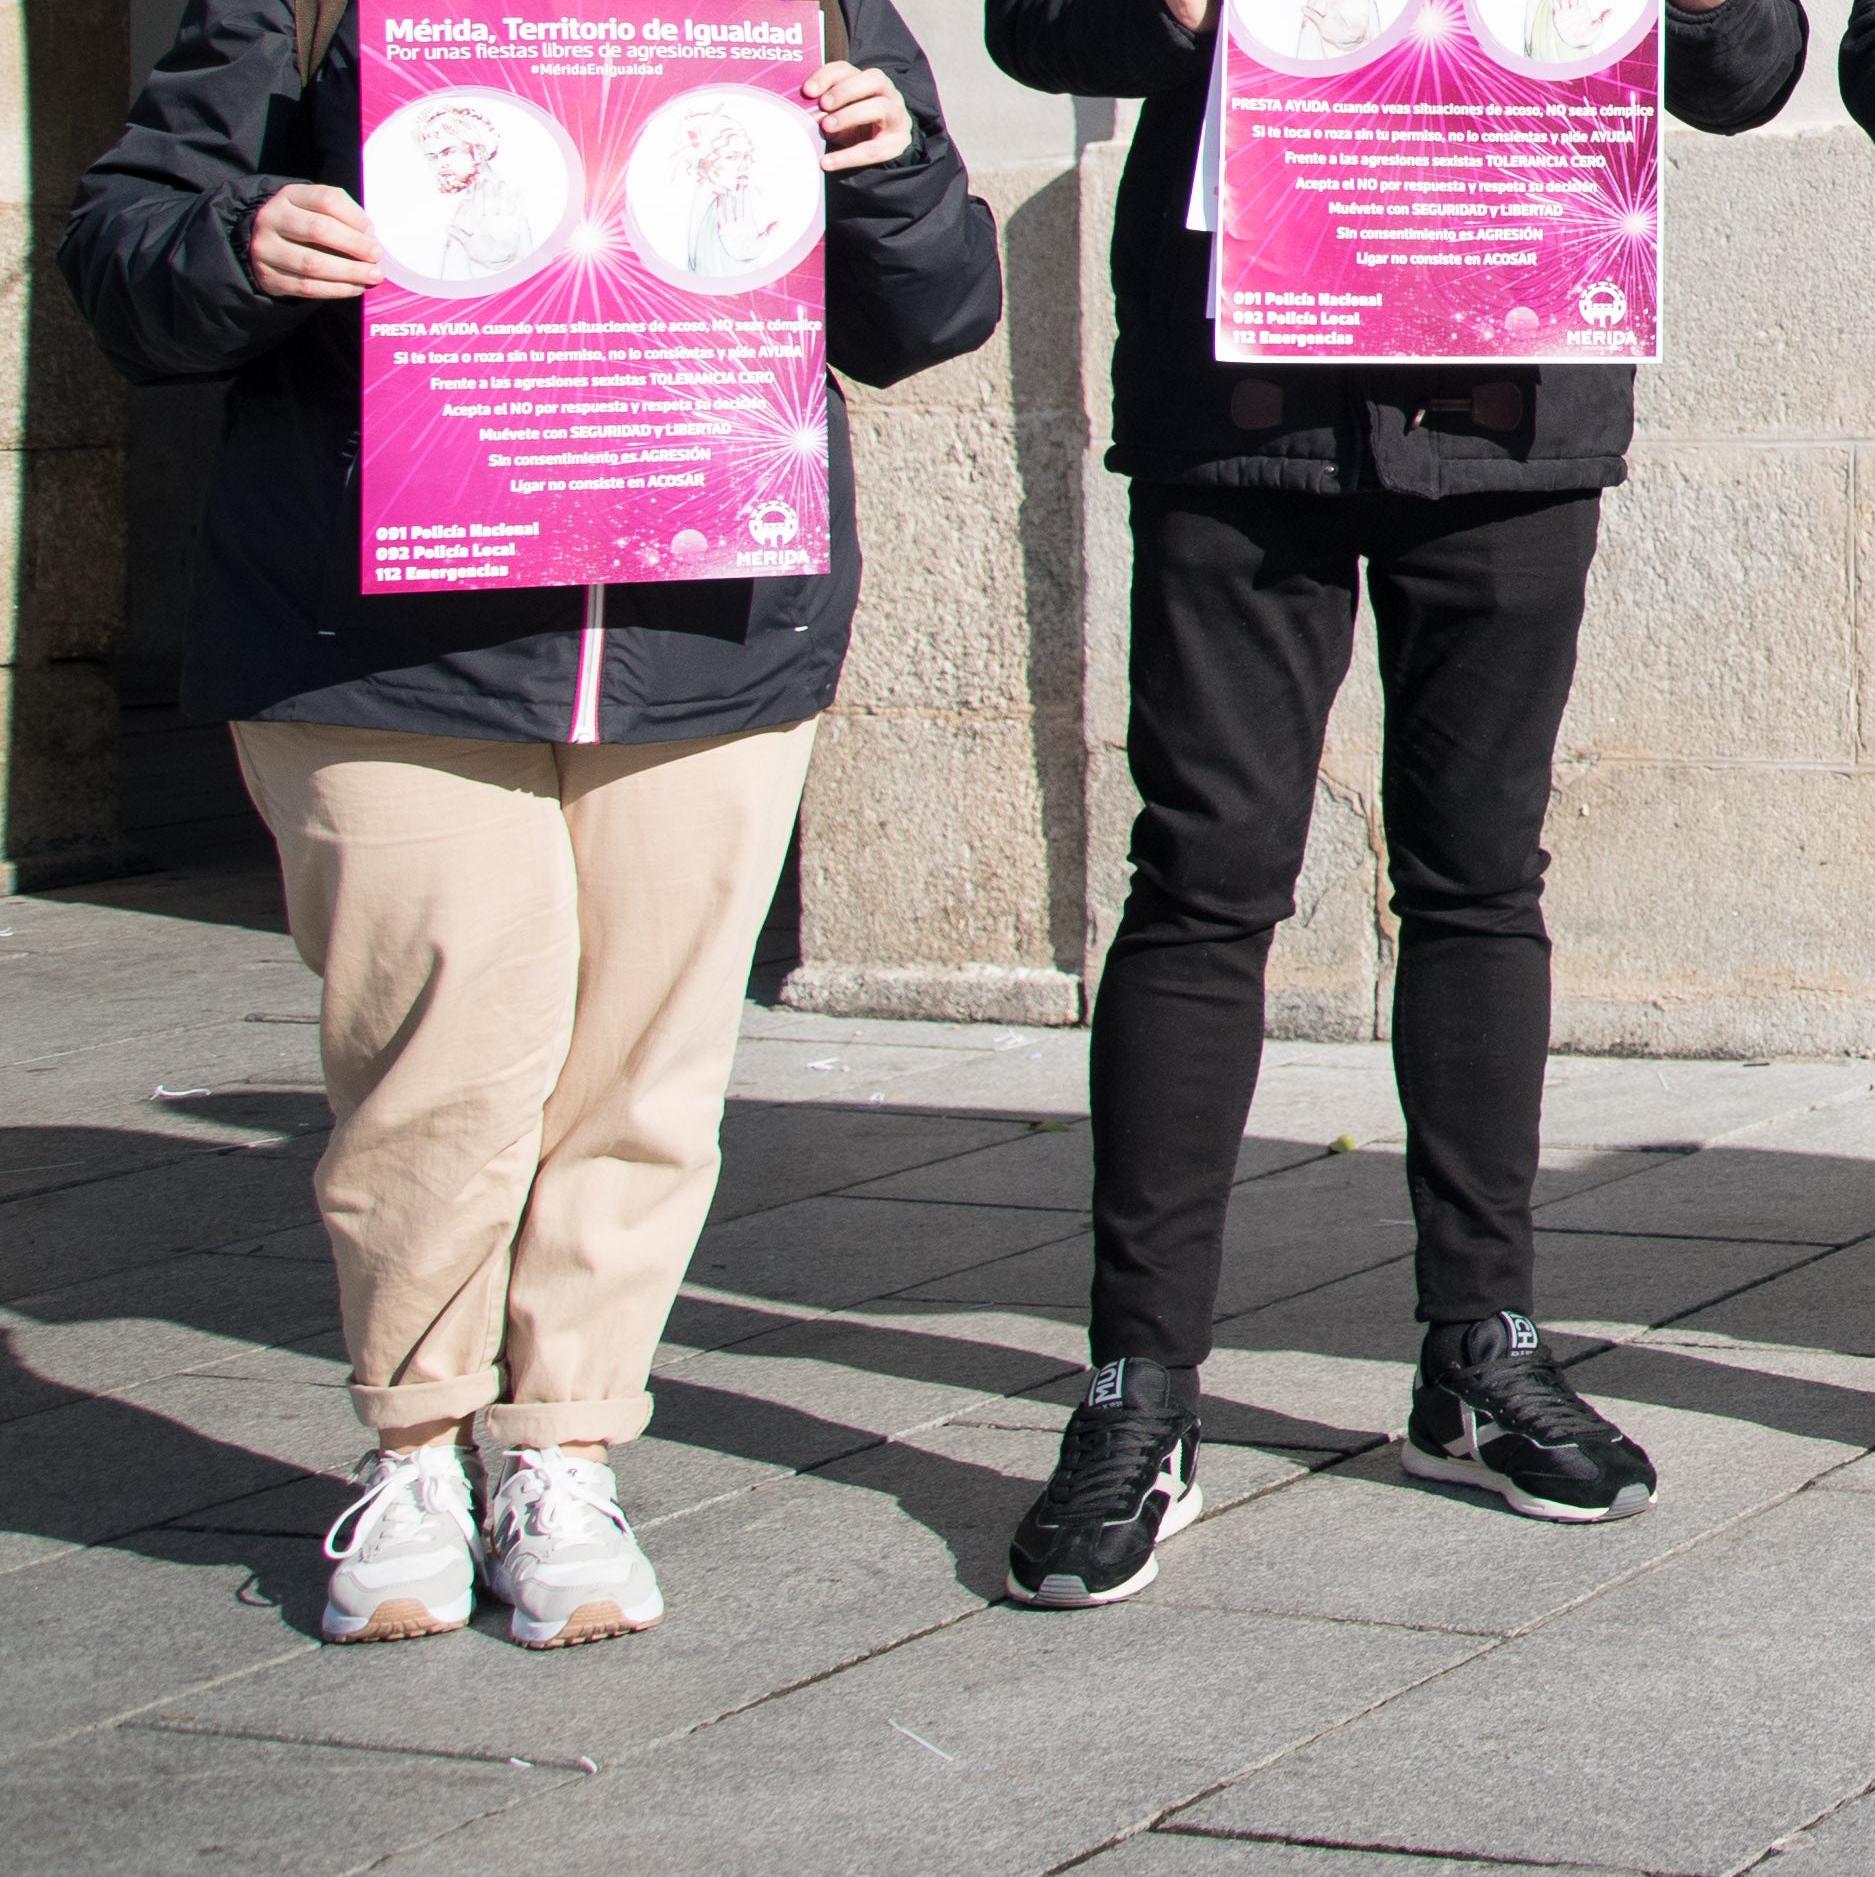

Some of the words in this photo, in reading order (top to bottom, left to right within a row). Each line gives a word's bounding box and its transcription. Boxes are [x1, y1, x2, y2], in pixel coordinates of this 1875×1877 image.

[386, 18, 496, 44] Mérida,
[503, 17, 636, 42] Territorio
[640, 18, 677, 42] de
[685, 19, 802, 46] Igualdad
